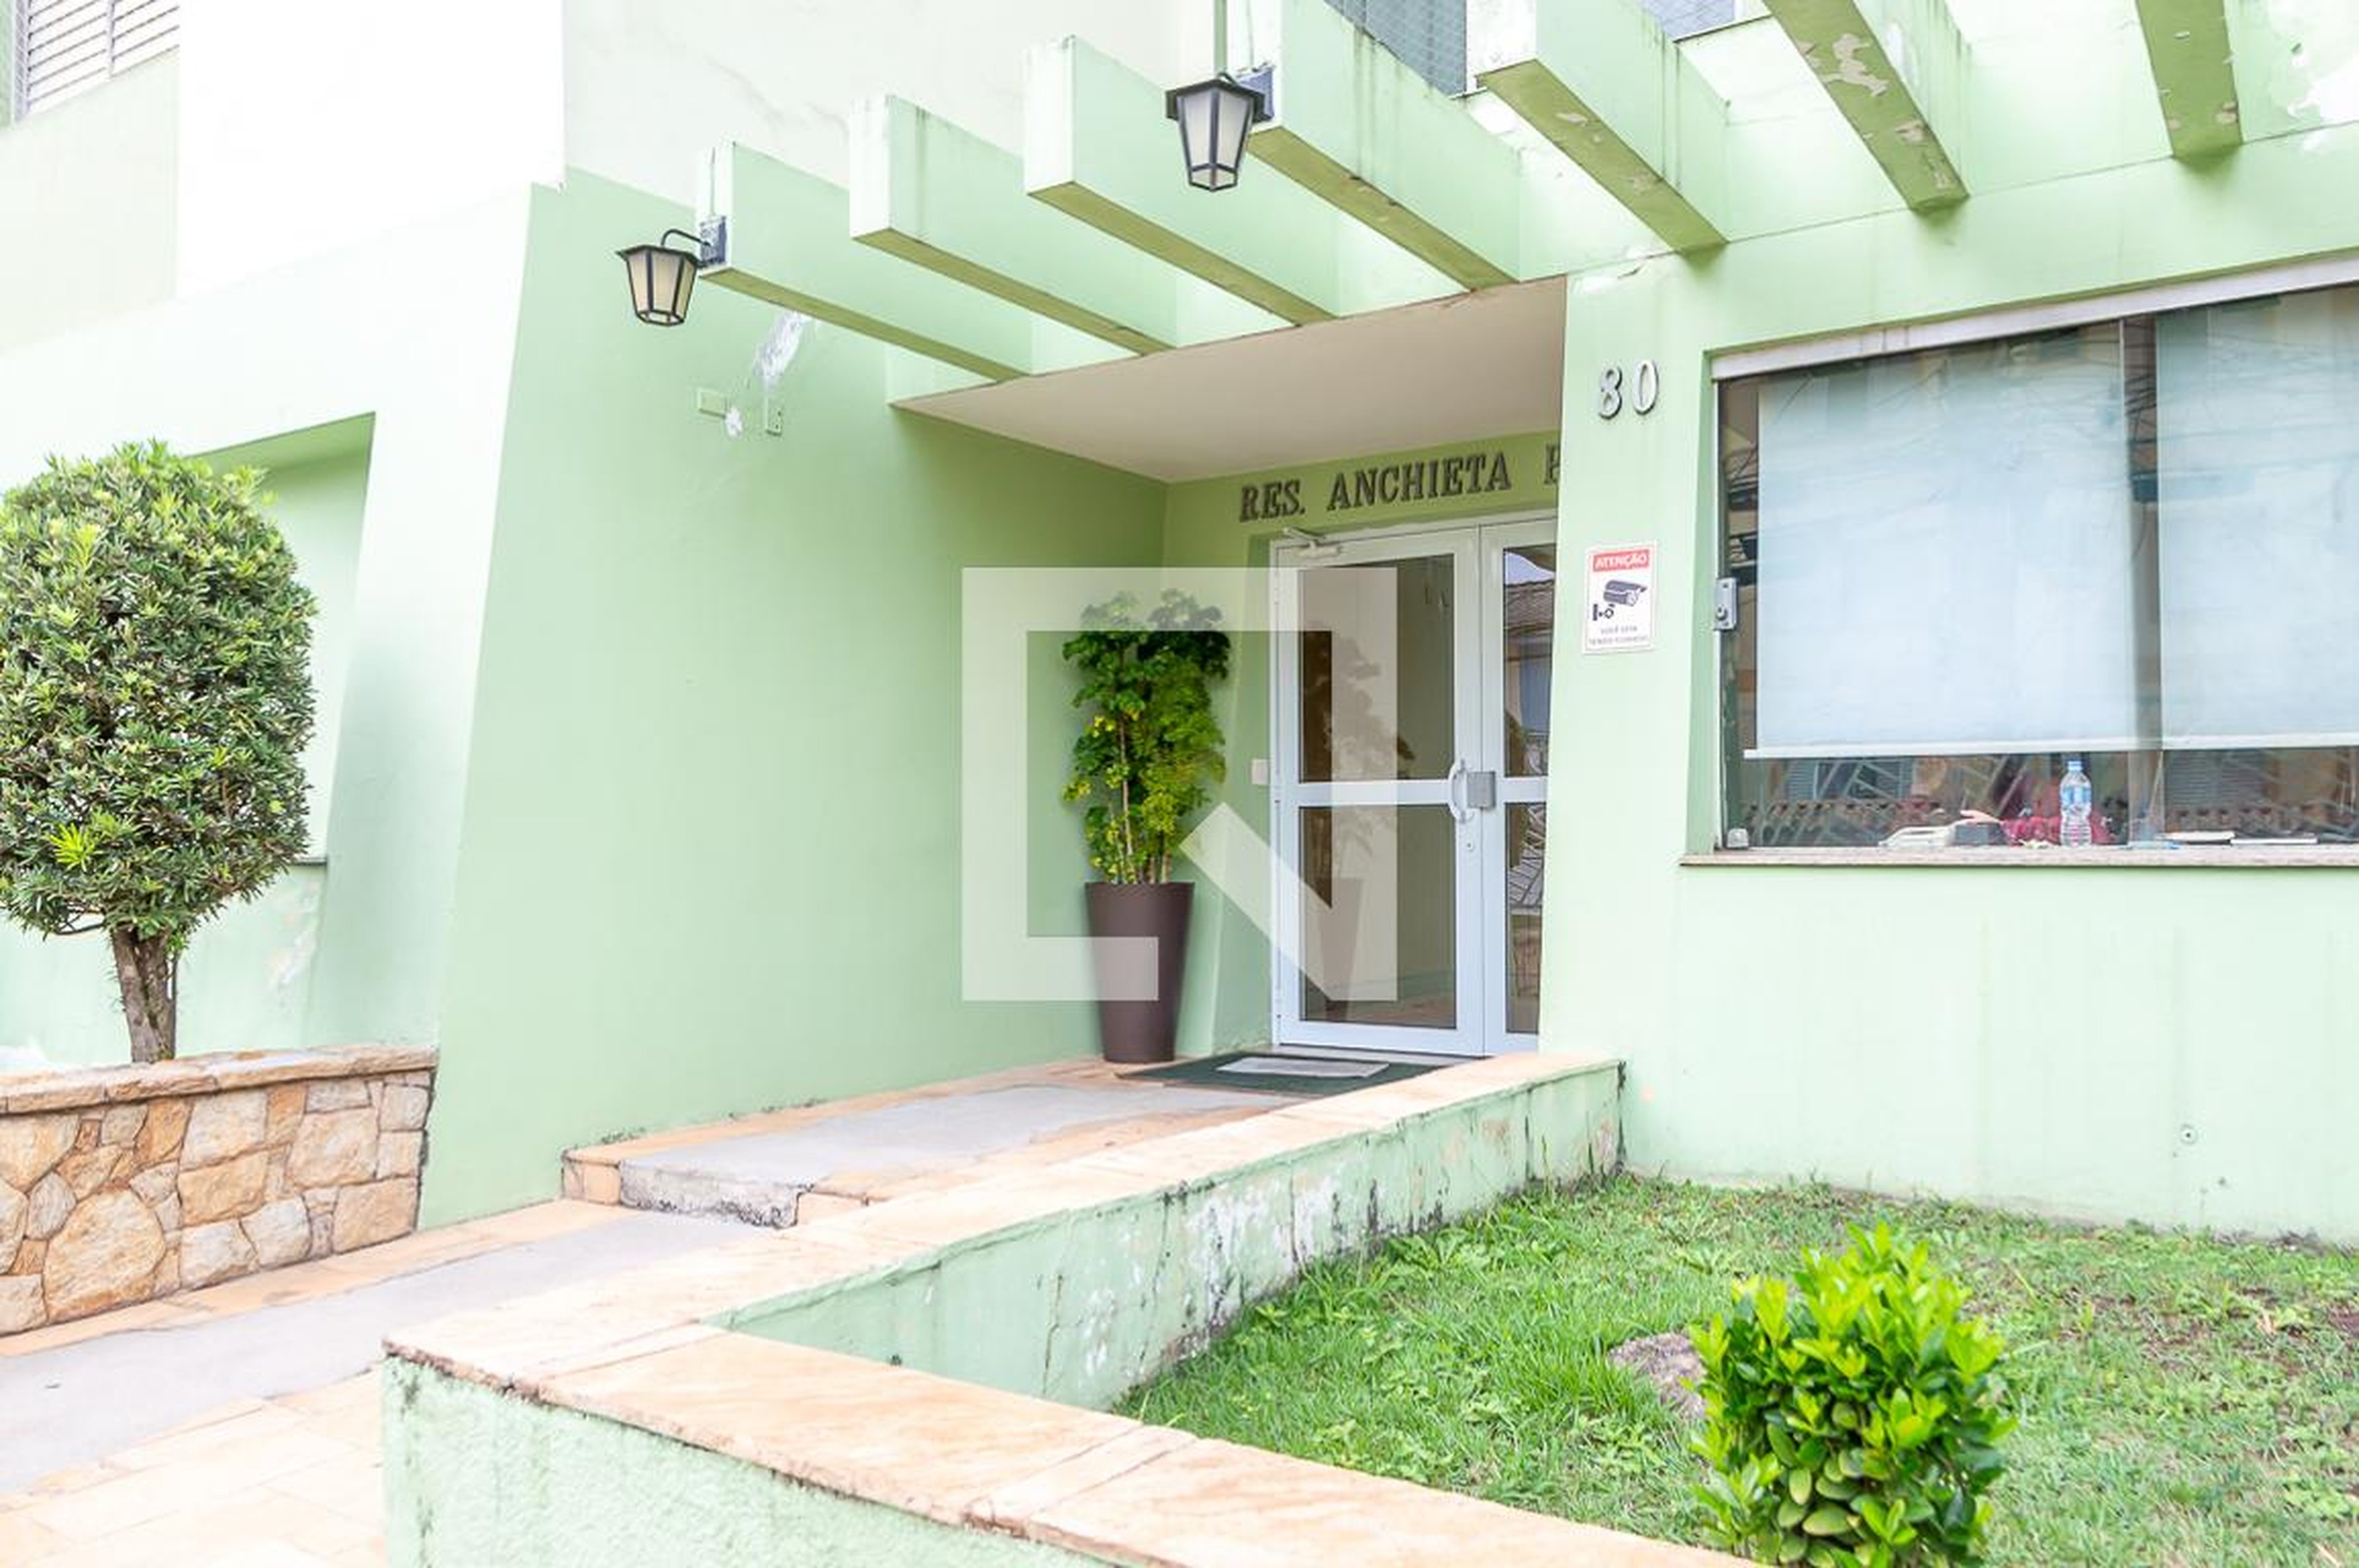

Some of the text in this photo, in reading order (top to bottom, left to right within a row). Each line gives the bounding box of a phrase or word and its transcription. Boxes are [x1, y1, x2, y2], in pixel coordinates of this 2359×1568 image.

[1598, 360, 1659, 419] 80
[1239, 478, 1306, 522] RES.
[1326, 451, 1512, 512] ANCHIETA
